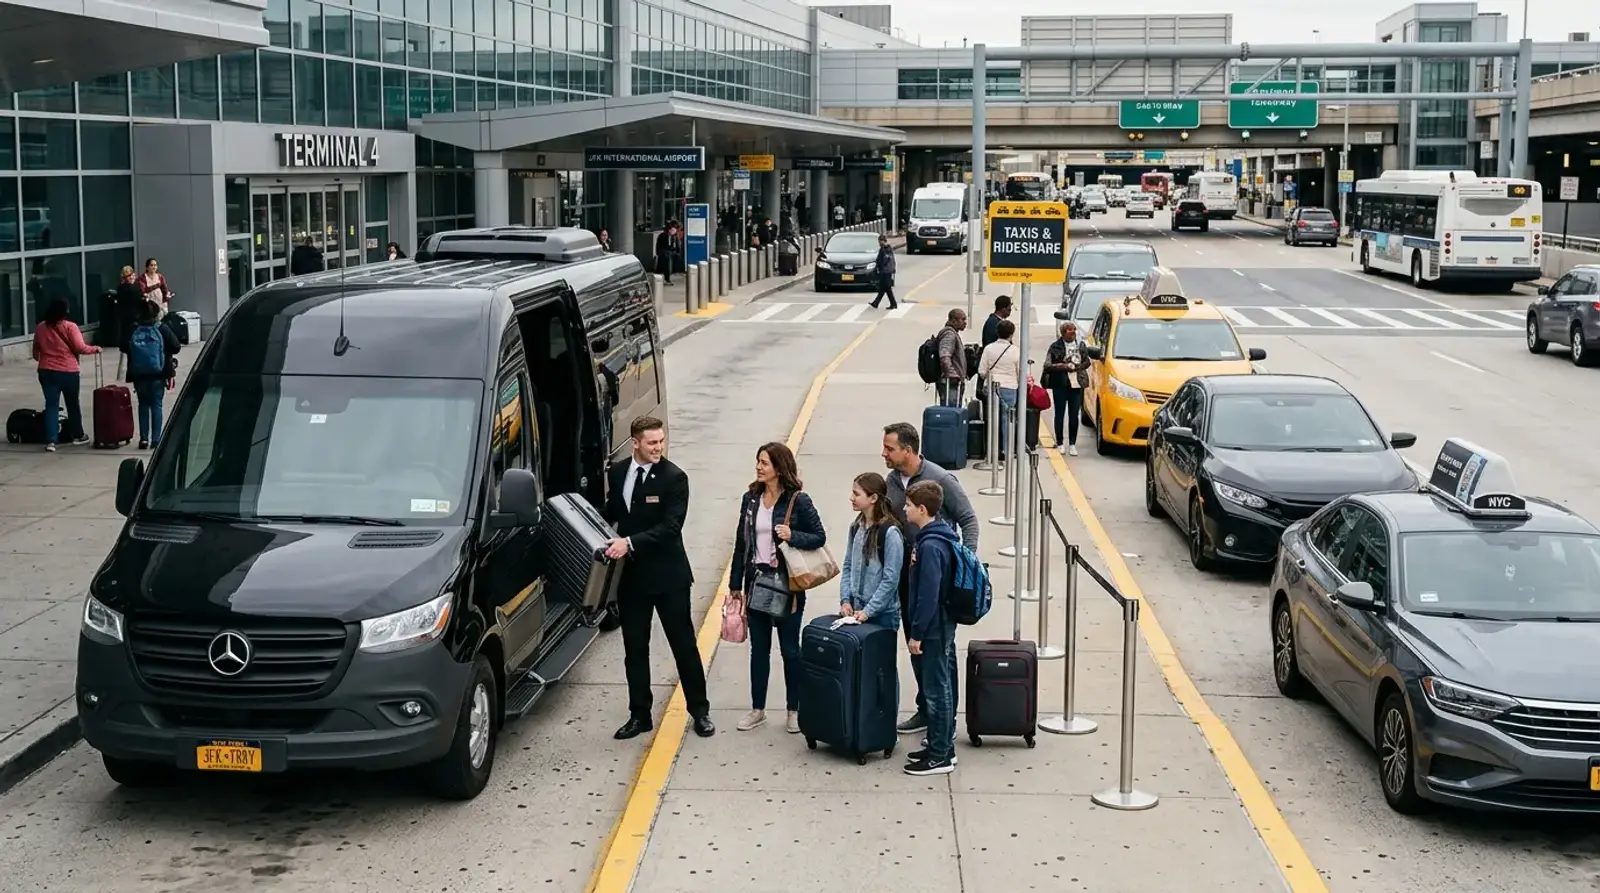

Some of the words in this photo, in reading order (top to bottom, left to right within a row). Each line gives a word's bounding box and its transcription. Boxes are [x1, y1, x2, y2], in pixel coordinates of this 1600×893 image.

[281, 133, 368, 167] TERMINAL
[370, 136, 380, 167] 4
[603, 154, 663, 162] INTERNATIONAL
[1003, 226, 1039, 239] TAXIS
[1042, 227, 1052, 240] &
[993, 241, 1061, 254] RIDESHARE
[1487, 496, 1512, 508] NYC
